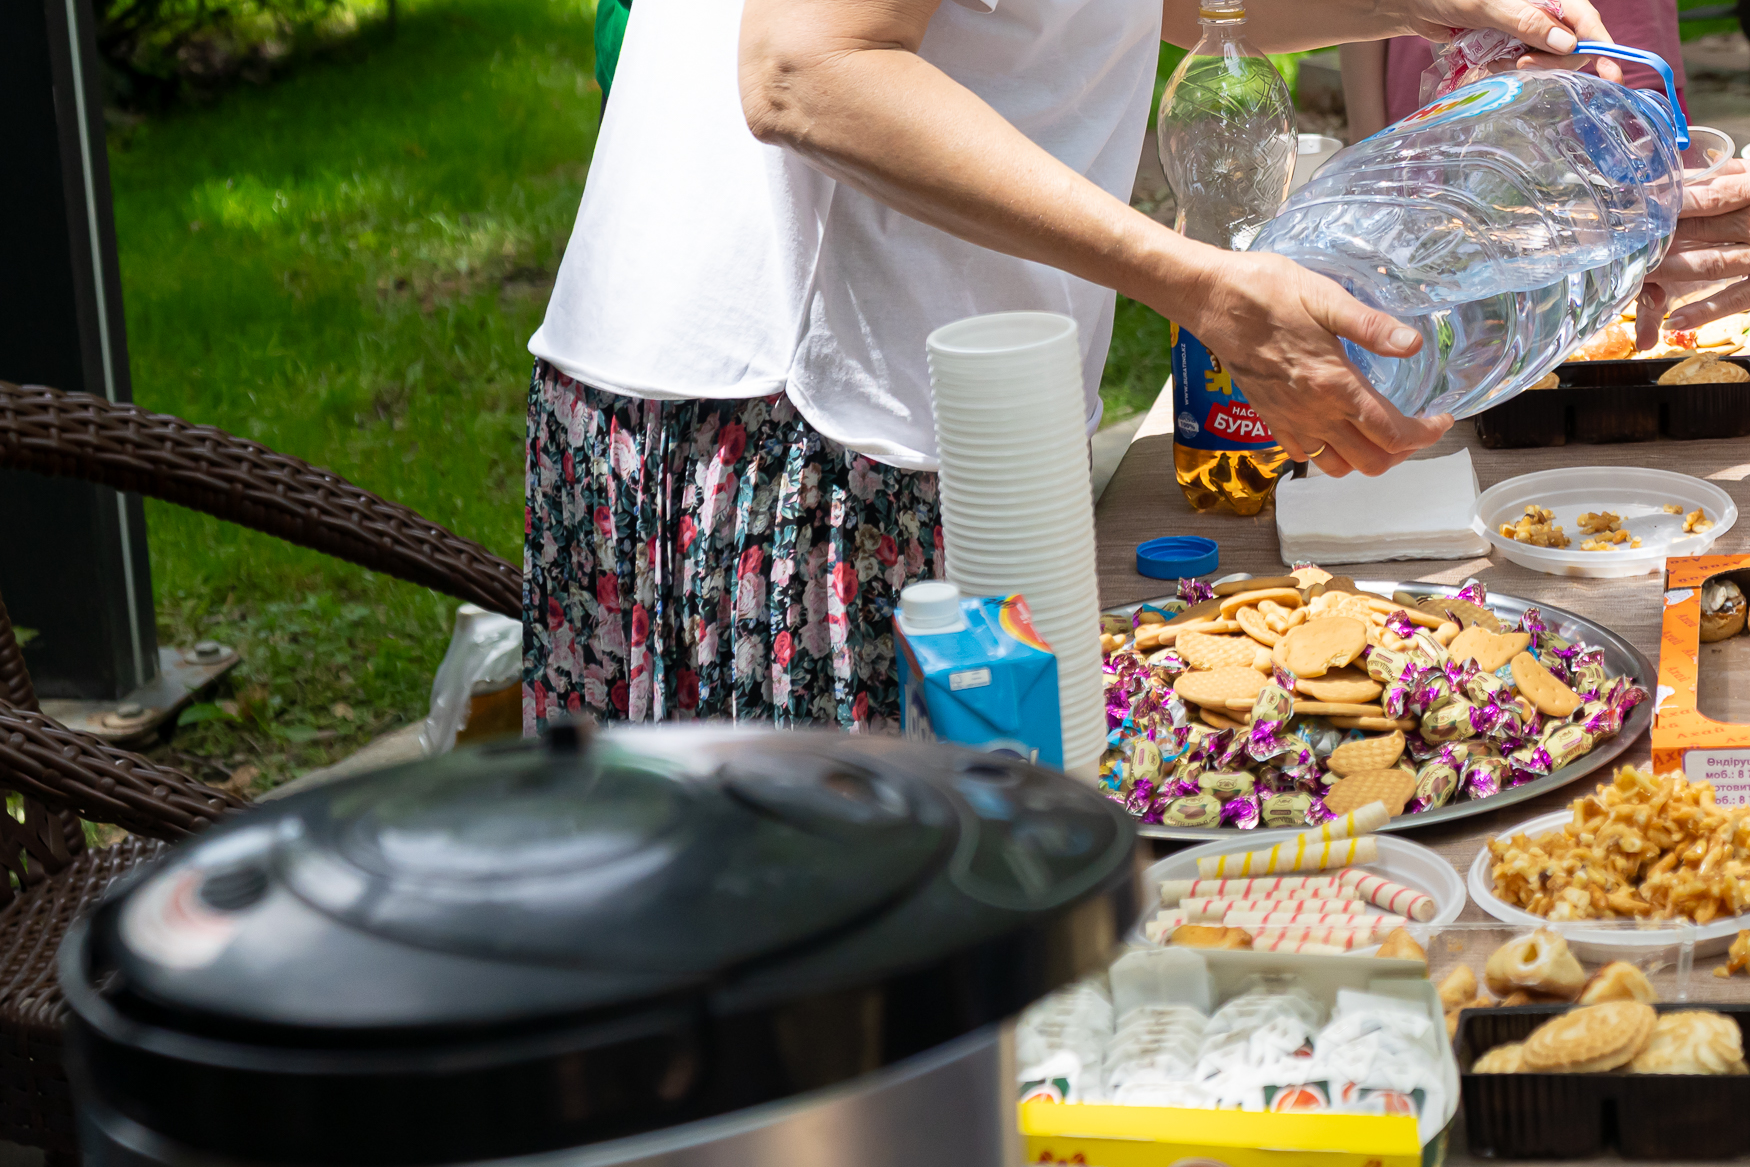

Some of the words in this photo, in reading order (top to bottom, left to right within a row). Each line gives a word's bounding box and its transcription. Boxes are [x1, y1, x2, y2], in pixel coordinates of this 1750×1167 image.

[1232, 406, 1260, 418] НАС
[1213, 412, 1272, 437] БУРА
[1705, 770, 1735, 780] моб.:
[1738, 770, 1744, 778] 8
[1715, 795, 1735, 805] об.:
[1739, 795, 1745, 804] 8
